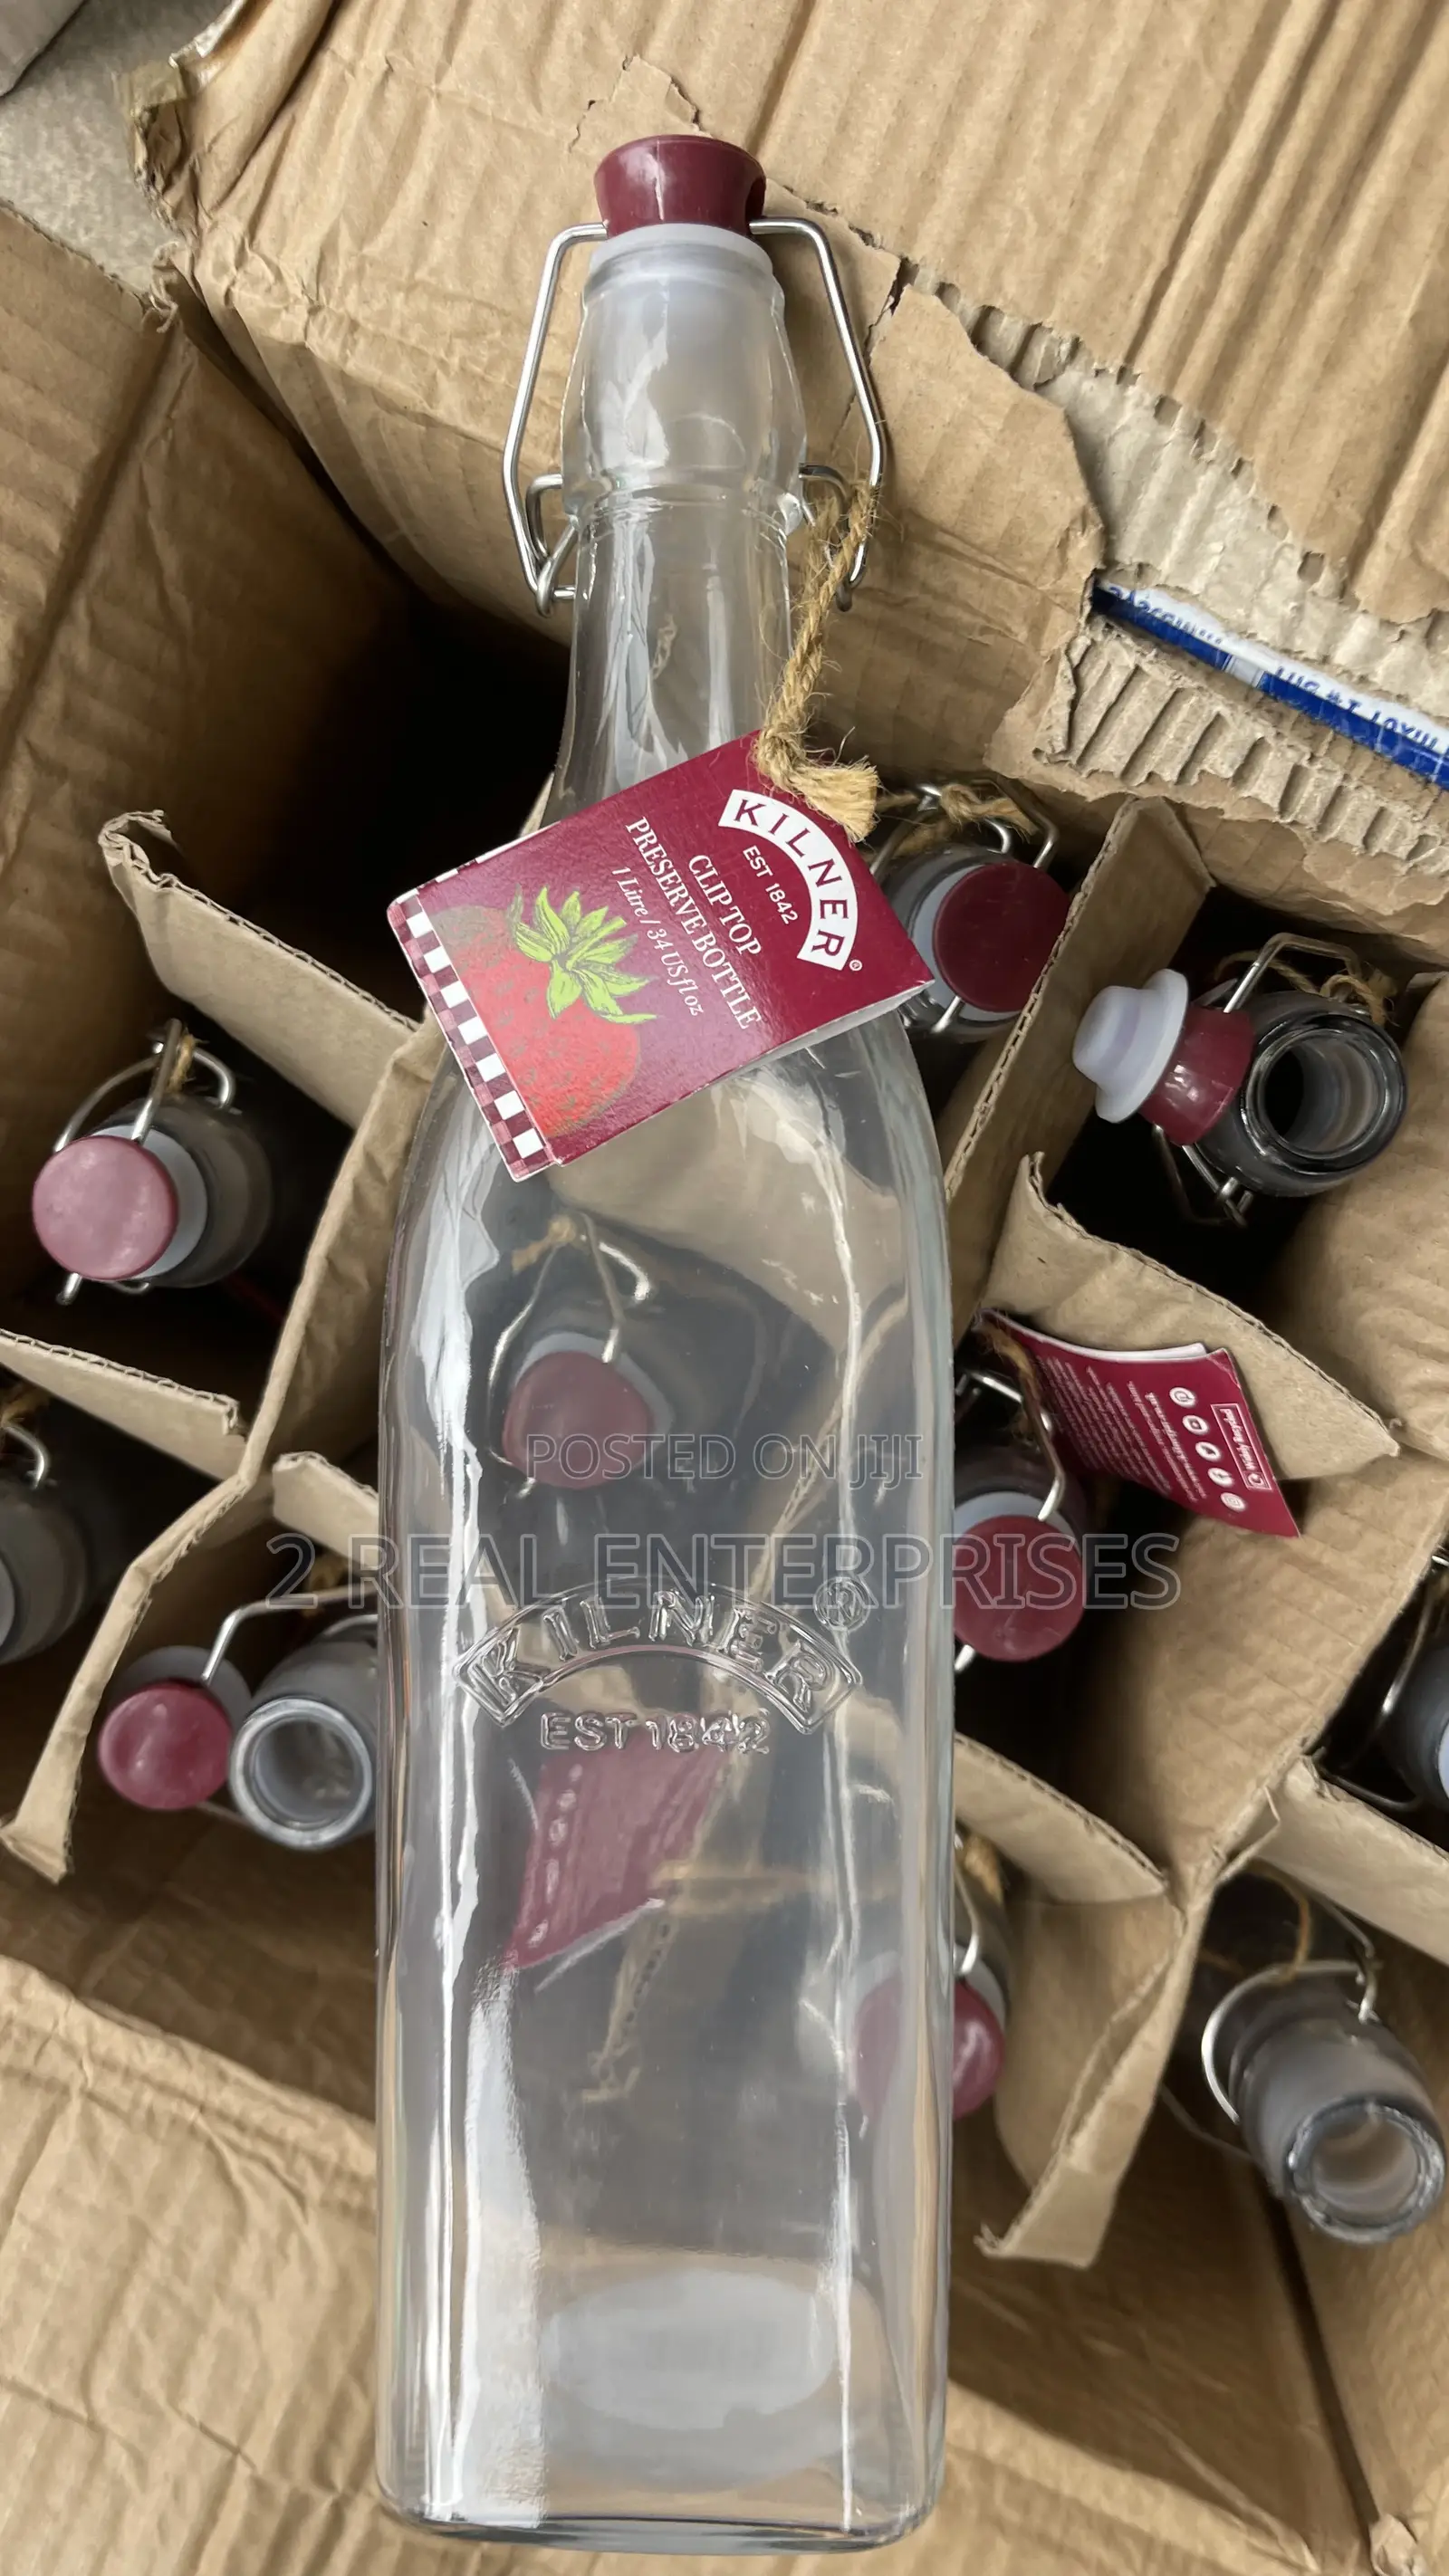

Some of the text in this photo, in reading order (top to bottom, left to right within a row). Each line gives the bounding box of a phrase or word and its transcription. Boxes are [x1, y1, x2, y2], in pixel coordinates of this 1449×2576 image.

[611, 867, 631, 876] 1
[617, 876, 649, 918] Litre
[688, 855, 762, 956] CLIP TOP
[733, 798, 849, 958] KILNER
[743, 845, 799, 924] EST 1842
[625, 816, 762, 1029] PRESERVE BOTTLE
[647, 927, 674, 951] 34
[468, 1589, 828, 1714] KILNER
[541, 1708, 772, 1756] EST 1842
